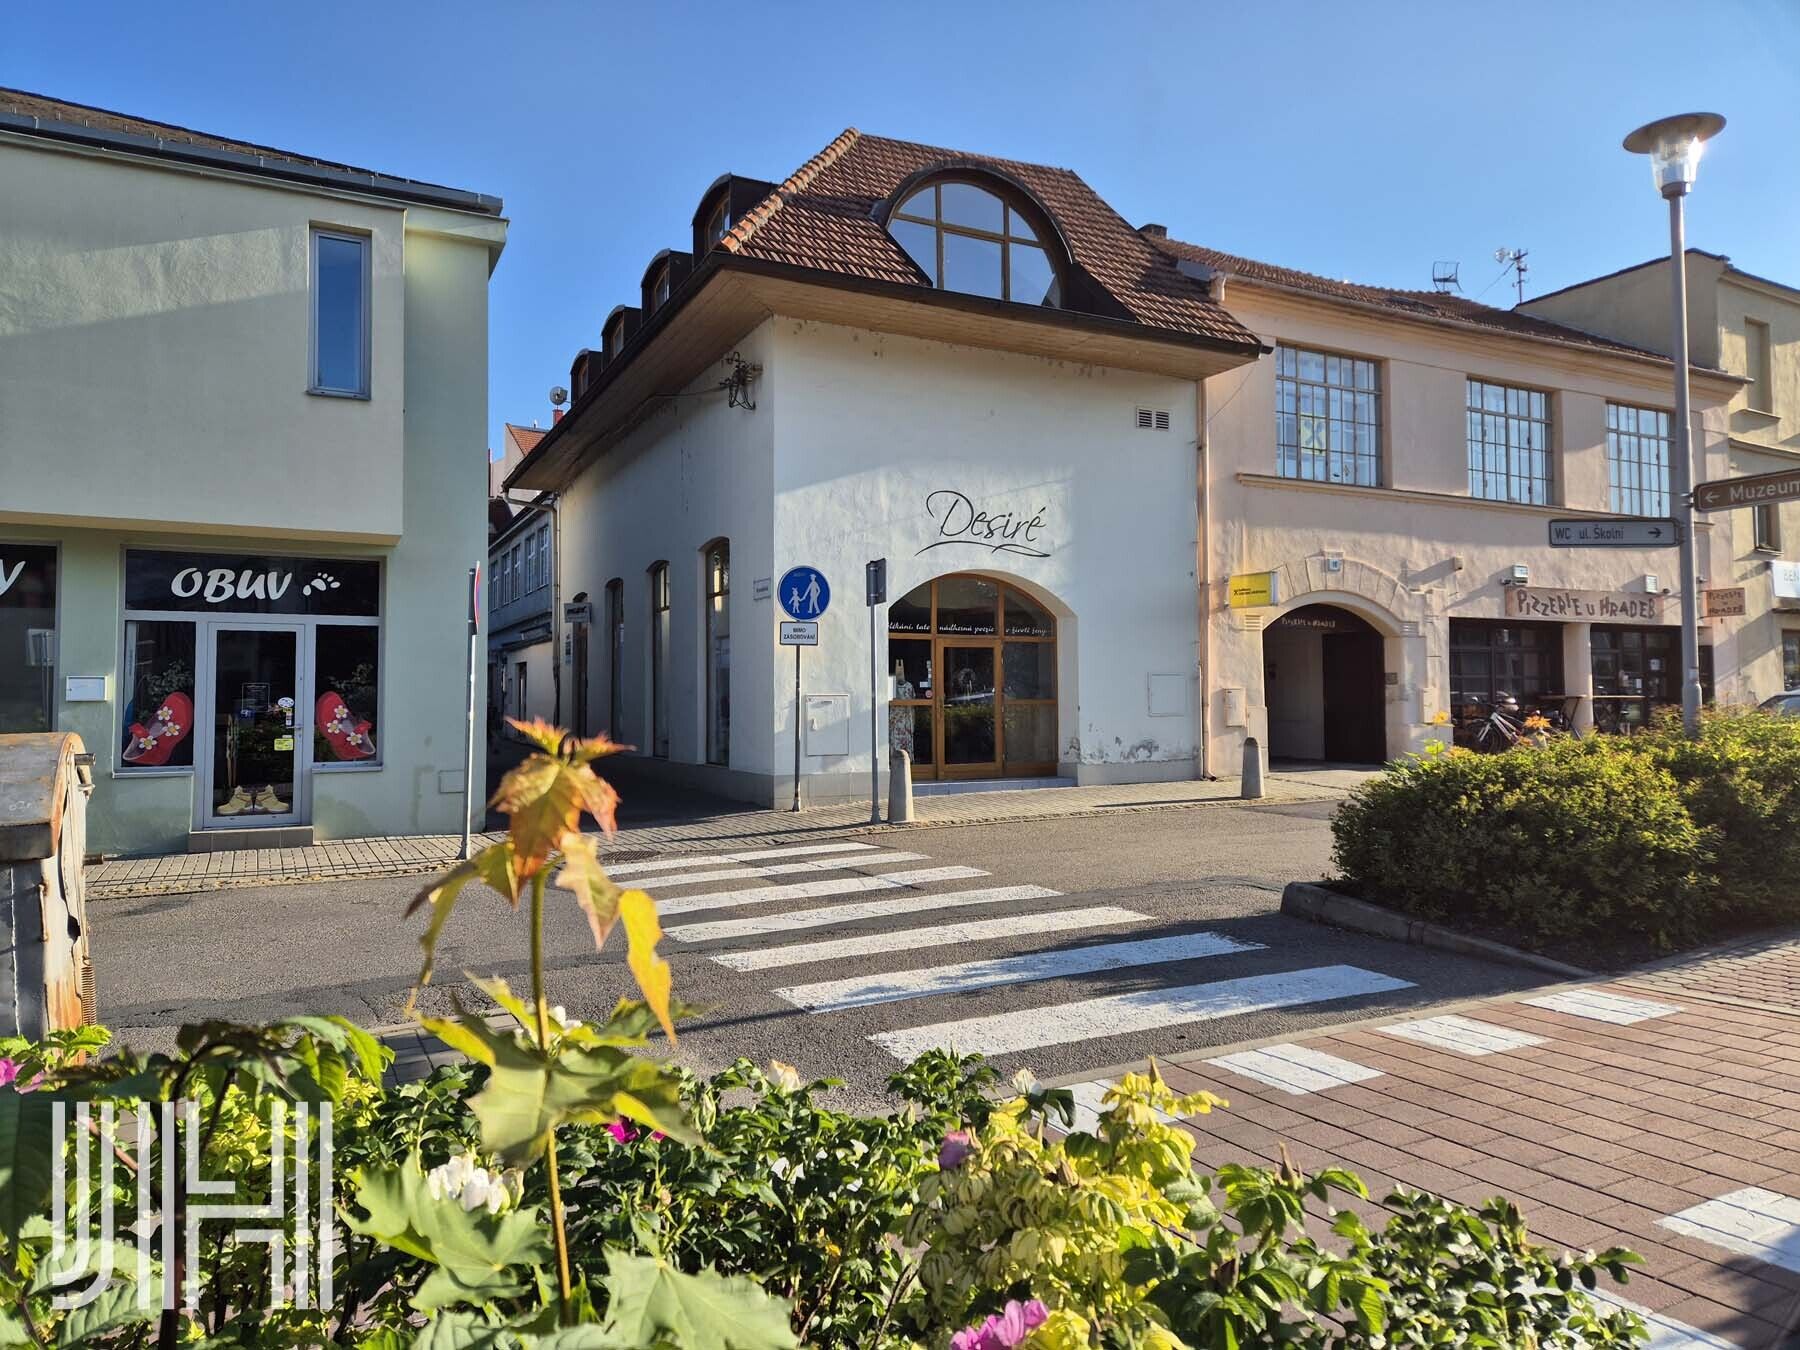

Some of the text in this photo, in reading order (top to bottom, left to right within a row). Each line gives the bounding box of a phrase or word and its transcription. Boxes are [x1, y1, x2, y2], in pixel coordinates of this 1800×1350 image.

[1730, 480, 1800, 501] Muzeum
[926, 490, 1047, 542] Desiré
[1554, 524, 1624, 540] WC ul. Školní
[171, 567, 293, 604] OBUV
